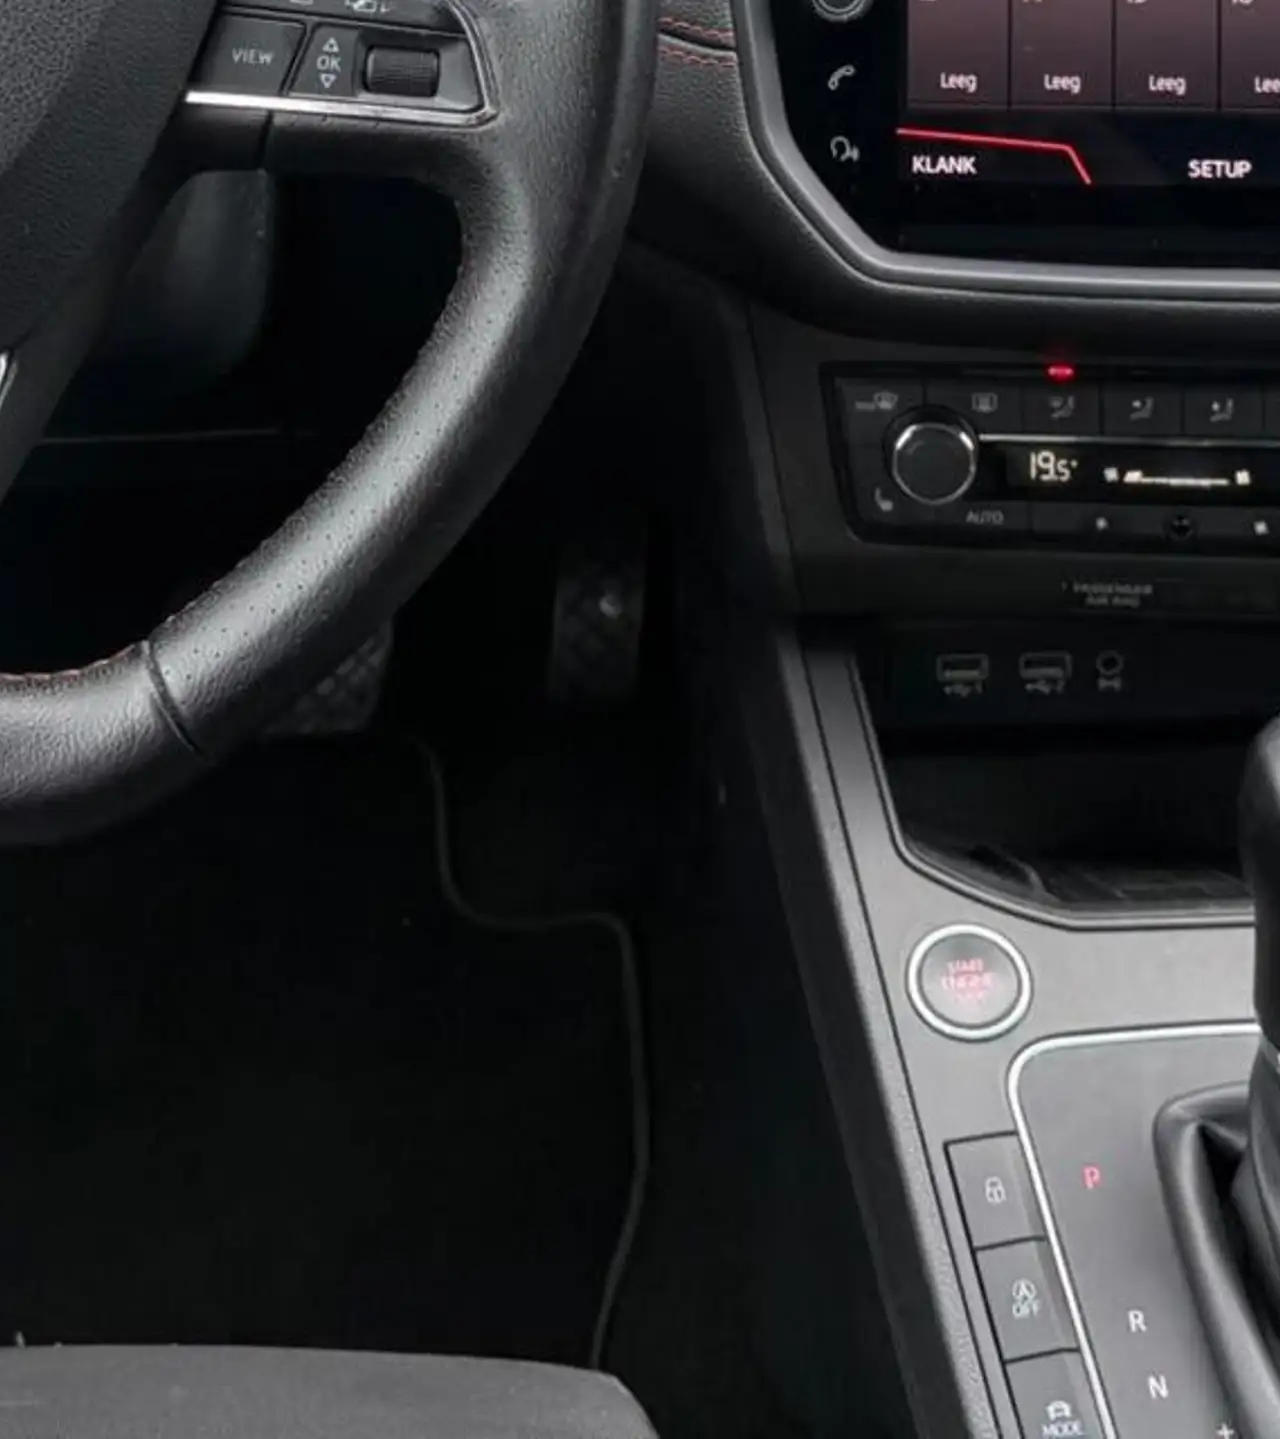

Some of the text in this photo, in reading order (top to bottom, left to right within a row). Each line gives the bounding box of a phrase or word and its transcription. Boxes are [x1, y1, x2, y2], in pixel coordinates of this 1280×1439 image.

[233, 49, 273, 64] VIEW
[316, 55, 342, 73] OK
[941, 74, 976, 92] Leeg
[1044, 75, 1080, 93] Leeg
[1149, 76, 1186, 95] Leeg
[913, 156, 975, 173] KLANK
[1189, 160, 1251, 178] SETUP
[1084, 1167, 1100, 1188] P
[1012, 1302, 1040, 1318] OFF
[1128, 1310, 1148, 1333] R
[1149, 1376, 1168, 1398] N
[1042, 1421, 1083, 1436] MODE
